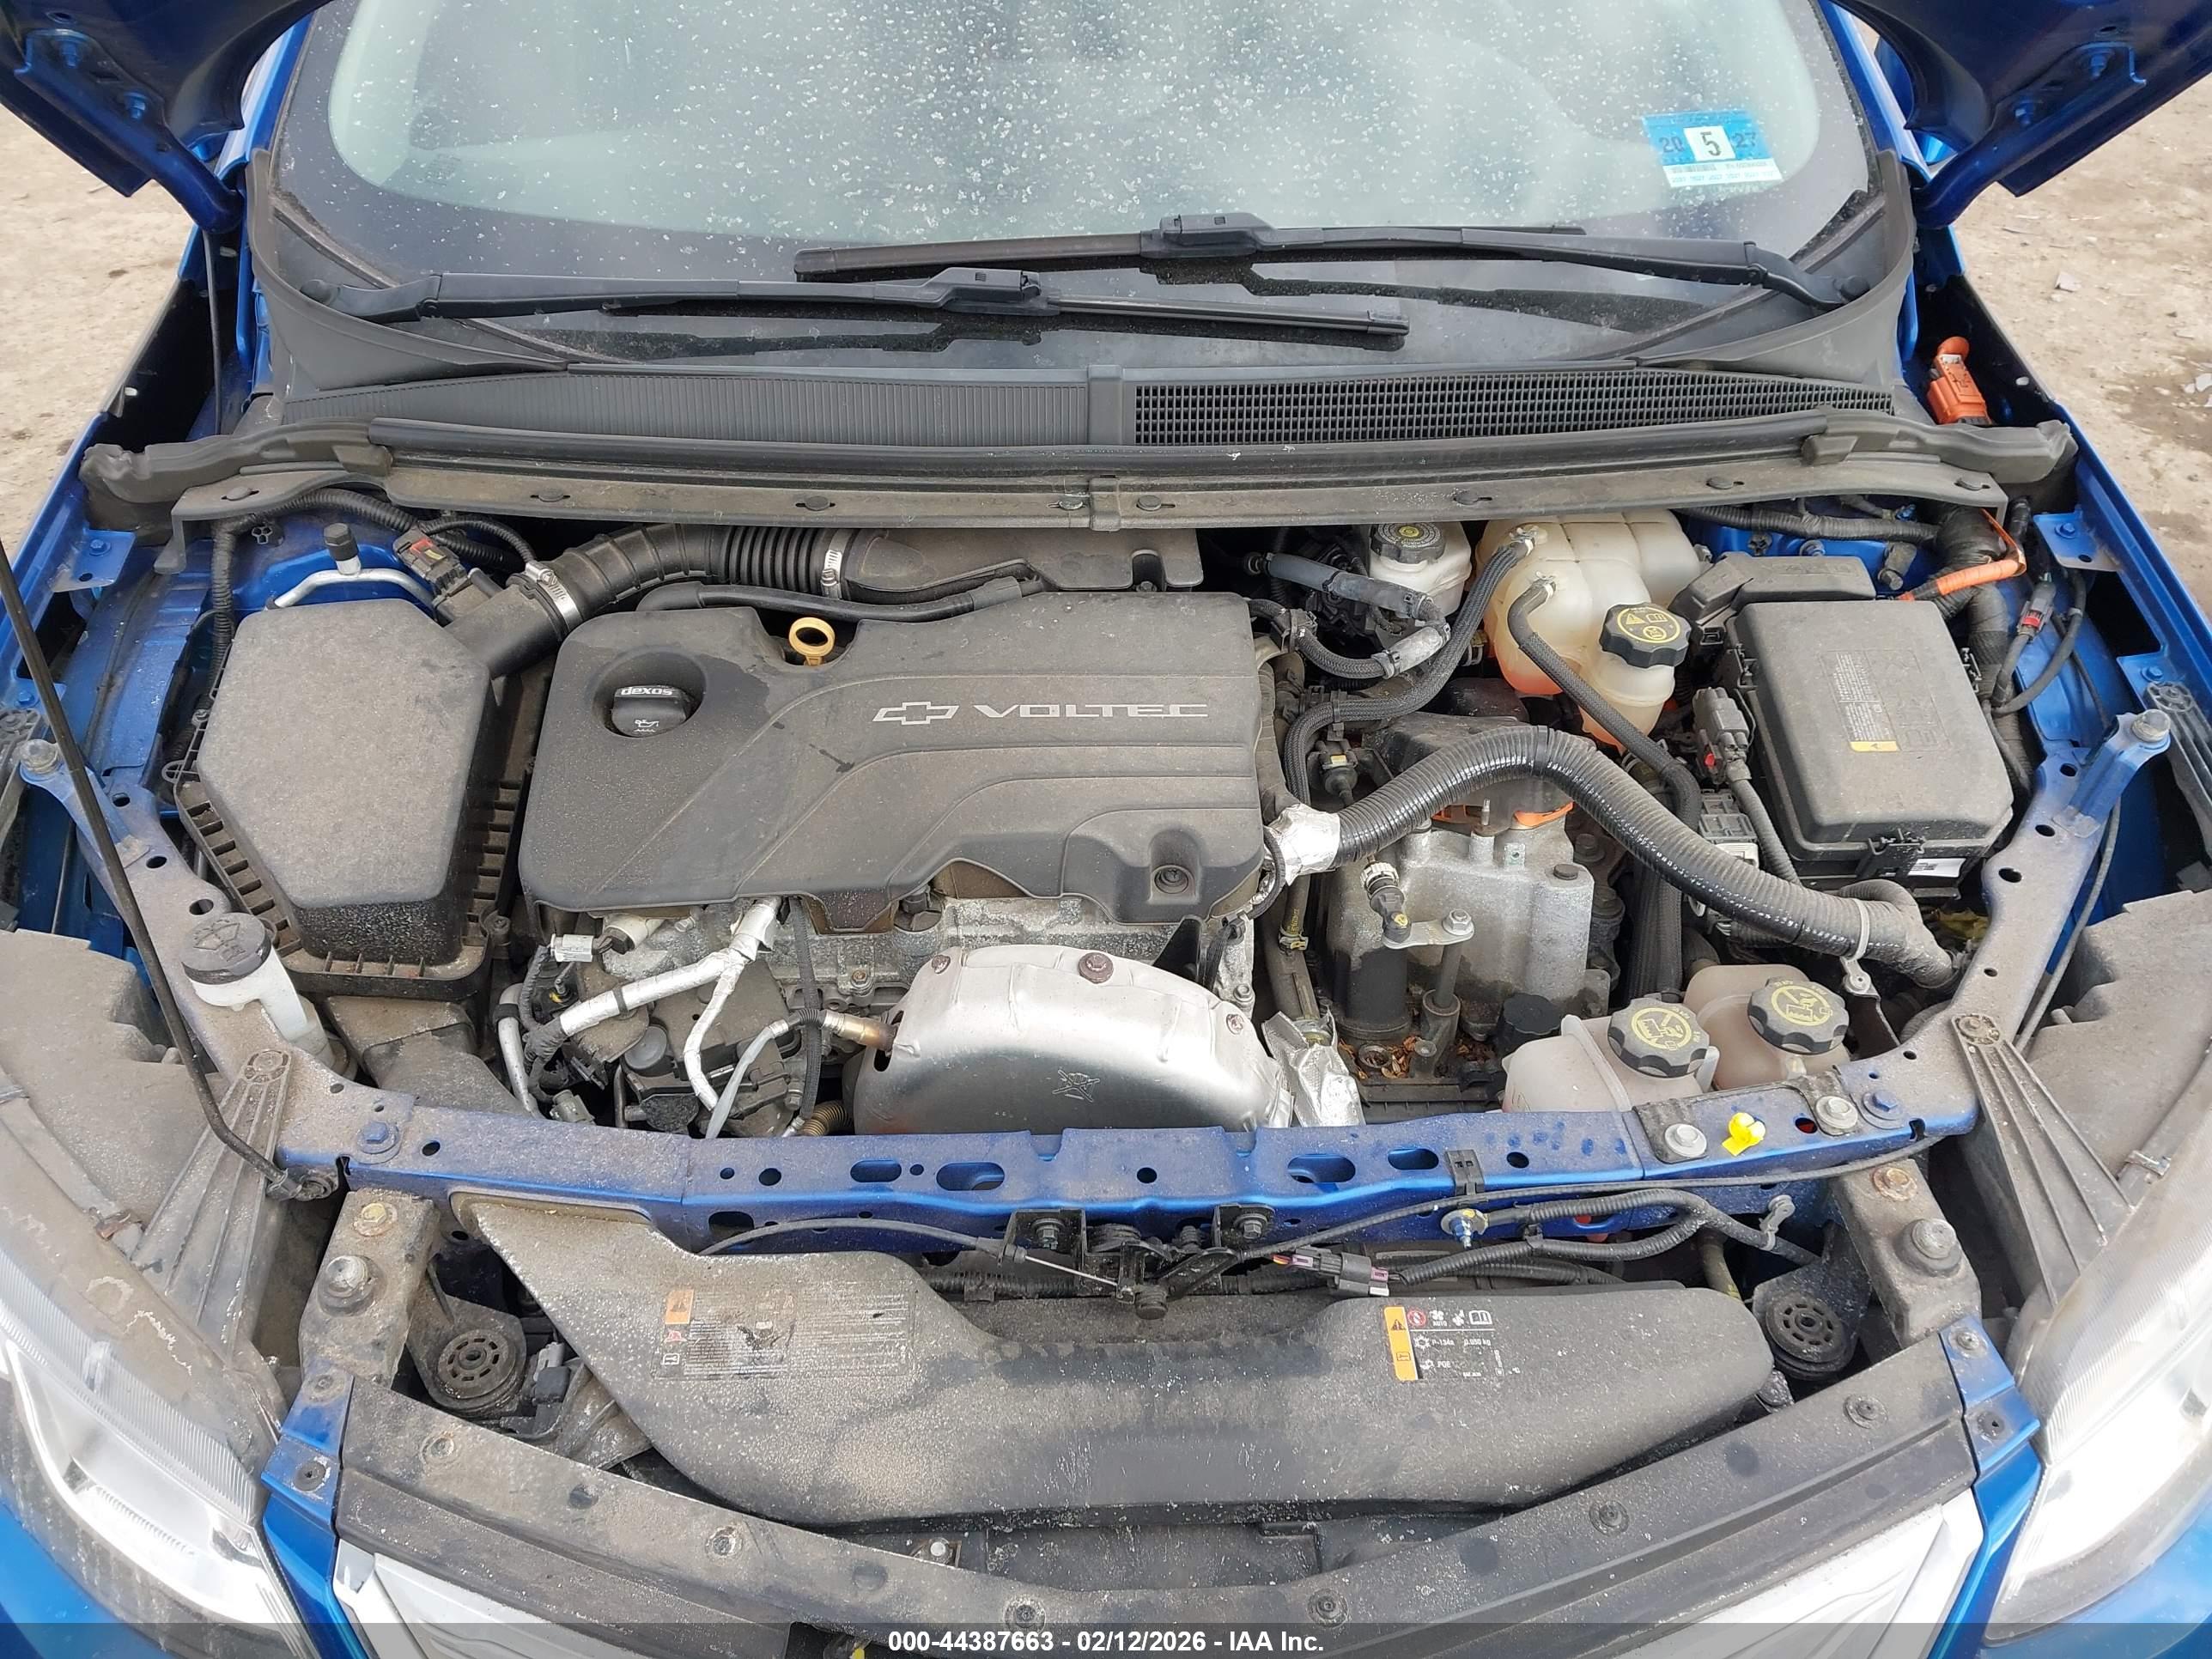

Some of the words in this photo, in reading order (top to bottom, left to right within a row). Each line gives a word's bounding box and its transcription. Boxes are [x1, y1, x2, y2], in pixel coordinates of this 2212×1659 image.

[1659, 135, 1684, 154] 20
[1699, 131, 1723, 157] 5
[620, 686, 673, 696] dexos
[973, 703, 1209, 719] VOLTEC
